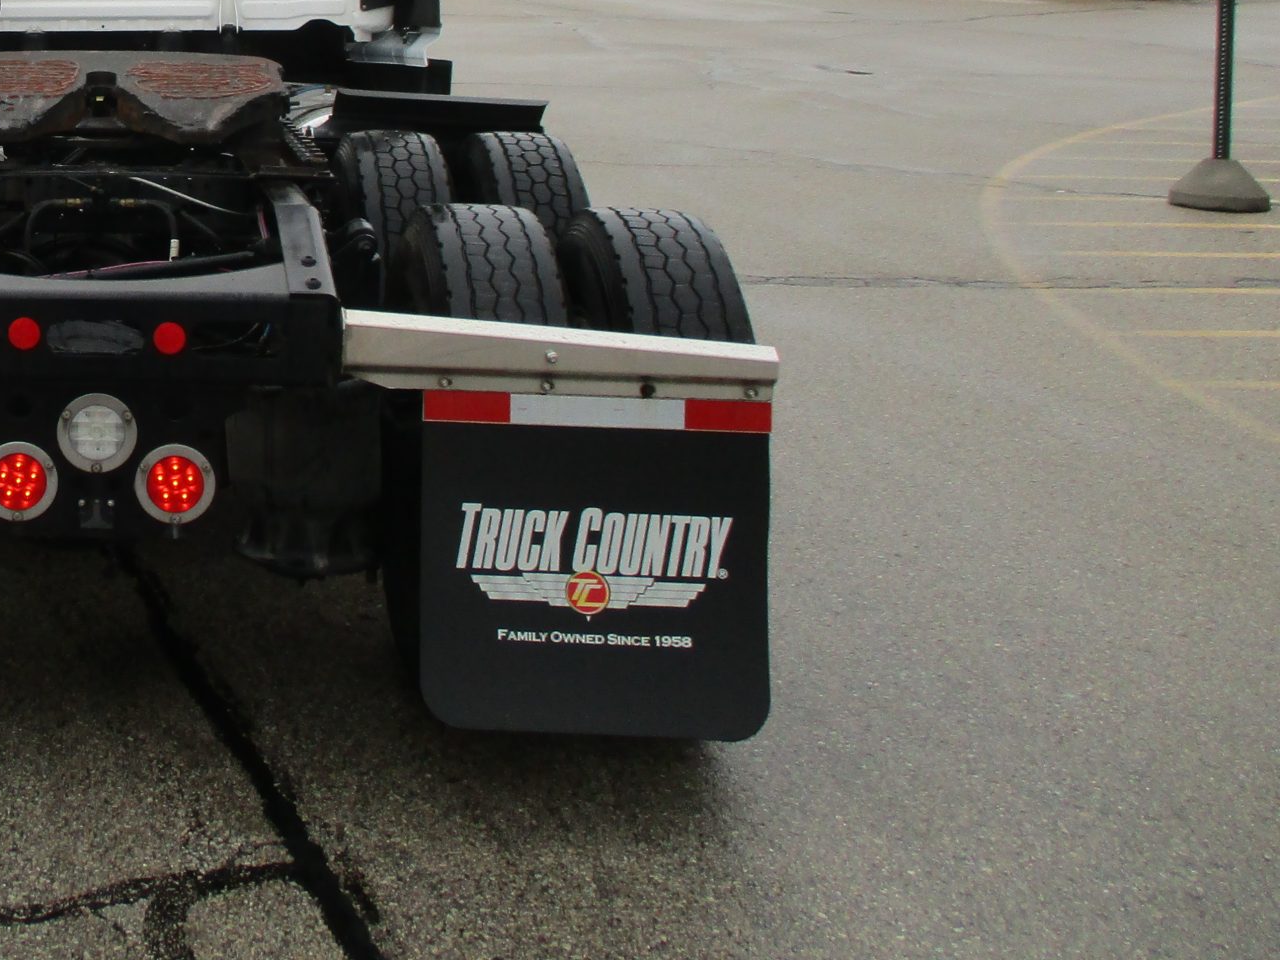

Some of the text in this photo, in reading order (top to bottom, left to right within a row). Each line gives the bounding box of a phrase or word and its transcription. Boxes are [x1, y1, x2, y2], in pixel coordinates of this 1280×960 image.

[456, 502, 733, 579] TRUCK COUNTRY
[497, 628, 693, 648] FAMILY OWNED SINCE 1958
